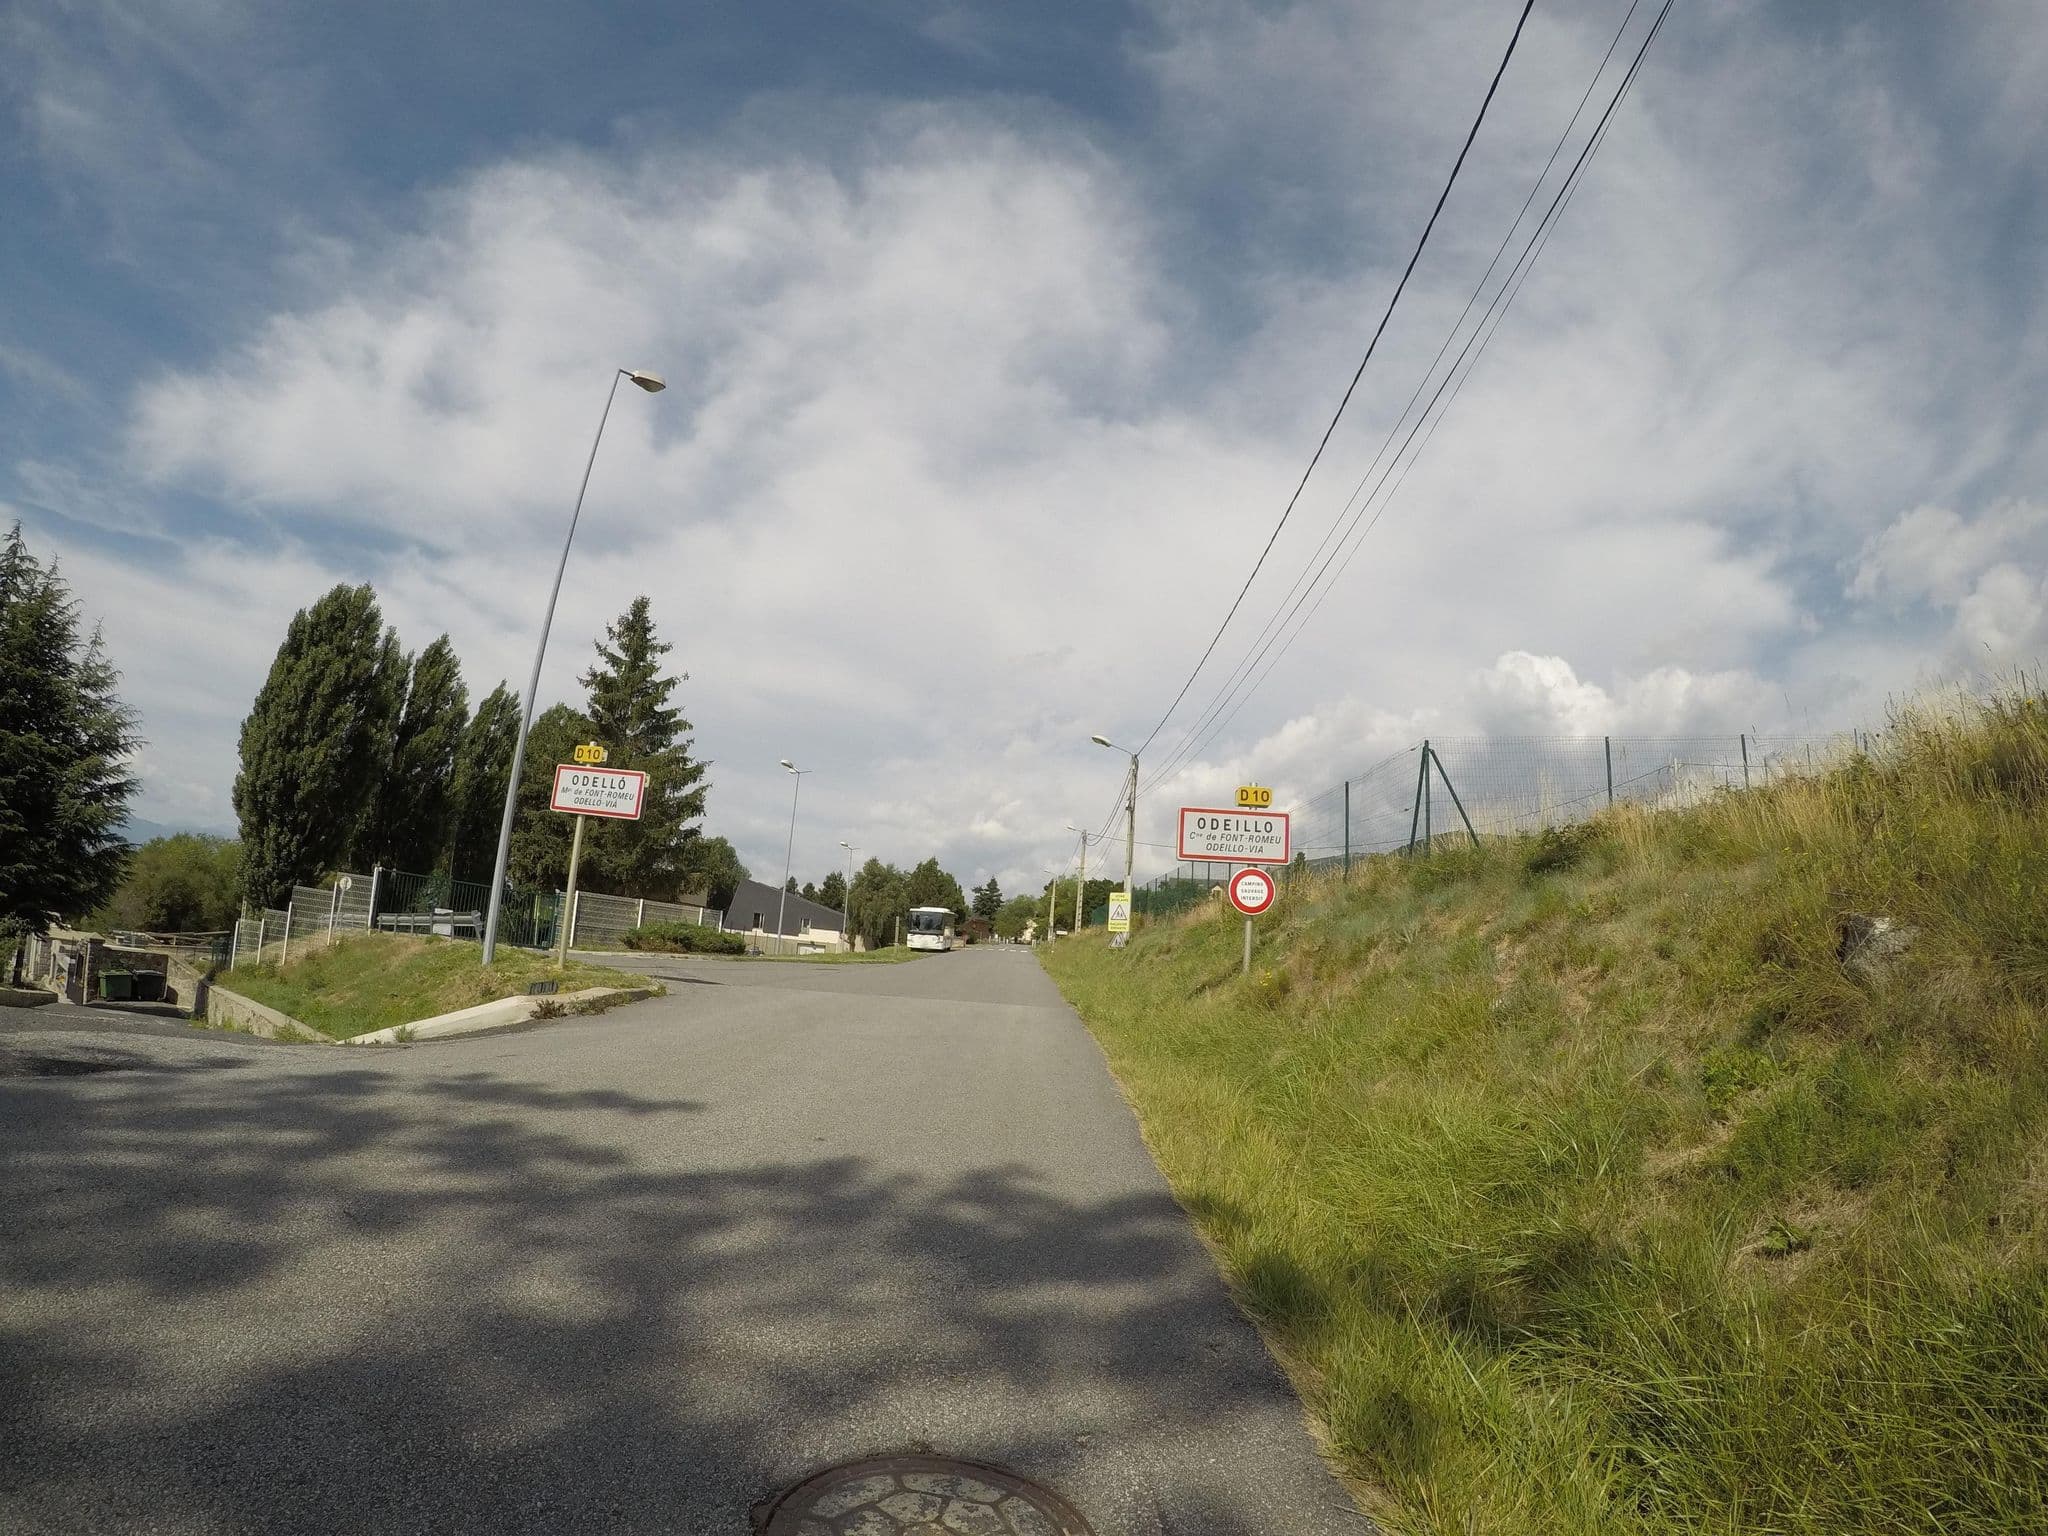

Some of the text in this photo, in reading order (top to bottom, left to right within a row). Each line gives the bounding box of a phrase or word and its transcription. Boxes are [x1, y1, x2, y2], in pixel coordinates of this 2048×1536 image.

[571, 774, 626, 790] ODELLÓ
[584, 789, 635, 801] FONT-ROMEU
[1197, 817, 1273, 833] ODEILLO
[1206, 833, 1217, 841] de
[1220, 833, 1282, 845] FONT-ROMEU
[1205, 843, 1264, 854] ODEILLO-VIA
